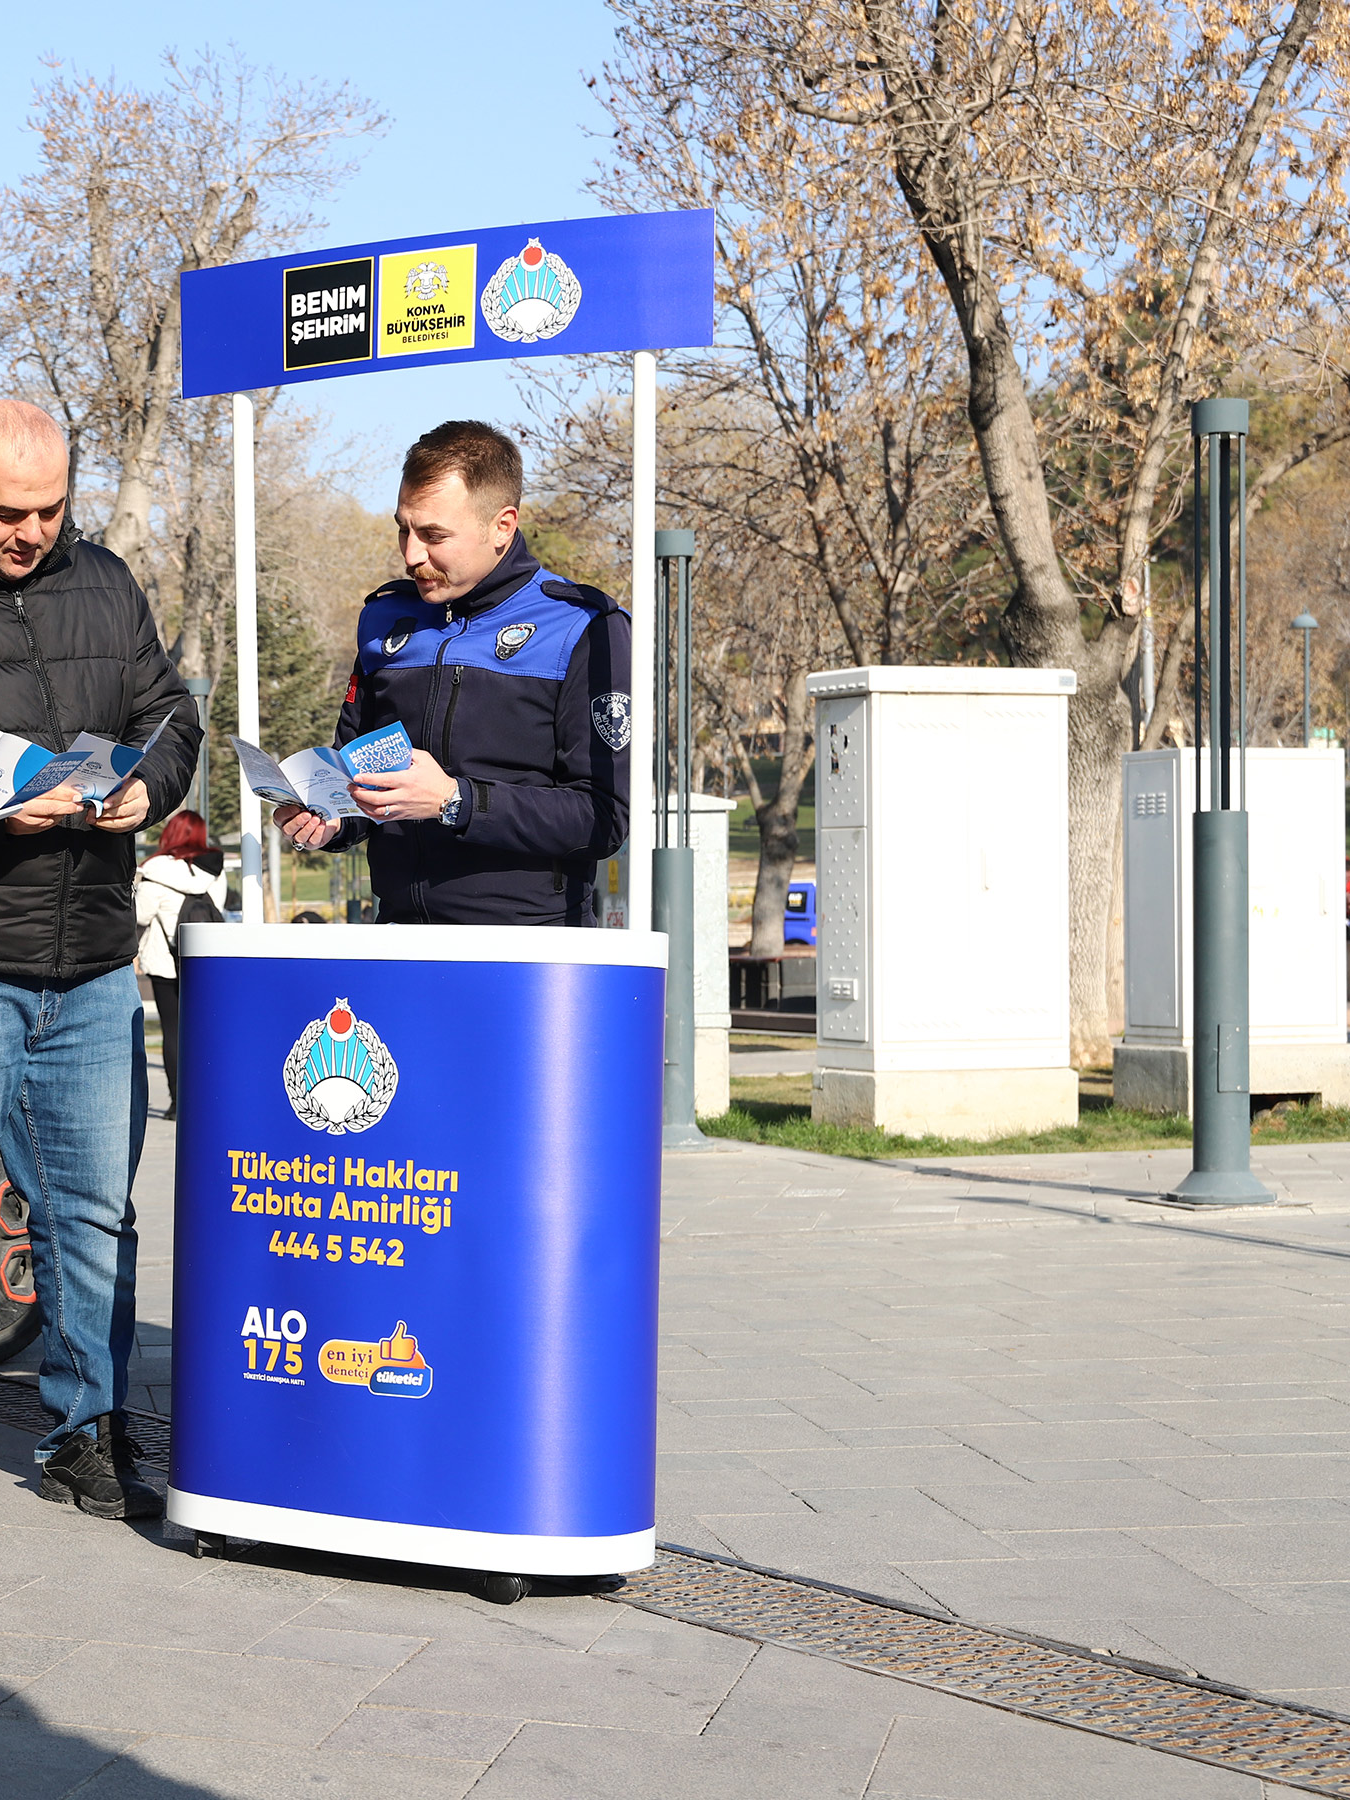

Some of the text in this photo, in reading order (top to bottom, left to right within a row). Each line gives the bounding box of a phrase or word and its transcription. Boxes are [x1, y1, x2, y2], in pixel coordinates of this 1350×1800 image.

[291, 284, 366, 317] BENİM
[407, 304, 445, 317] KONYA
[291, 312, 366, 345] ŞEHRİM
[387, 313, 465, 335] BÜYÜKŞEHİR
[402, 331, 449, 343] BELEDİYESİ
[600, 694, 628, 705] KONYA
[227, 1150, 459, 1192] Tüketici Hakları
[231, 1184, 451, 1235] Zabıta Amirliği
[269, 1230, 405, 1267] 444 5 542
[240, 1305, 307, 1342] ALO
[243, 1338, 303, 1375] 175
[327, 1347, 373, 1366] en iyi
[327, 1365, 369, 1381] denetçi
[376, 1371, 424, 1386] tüketici
